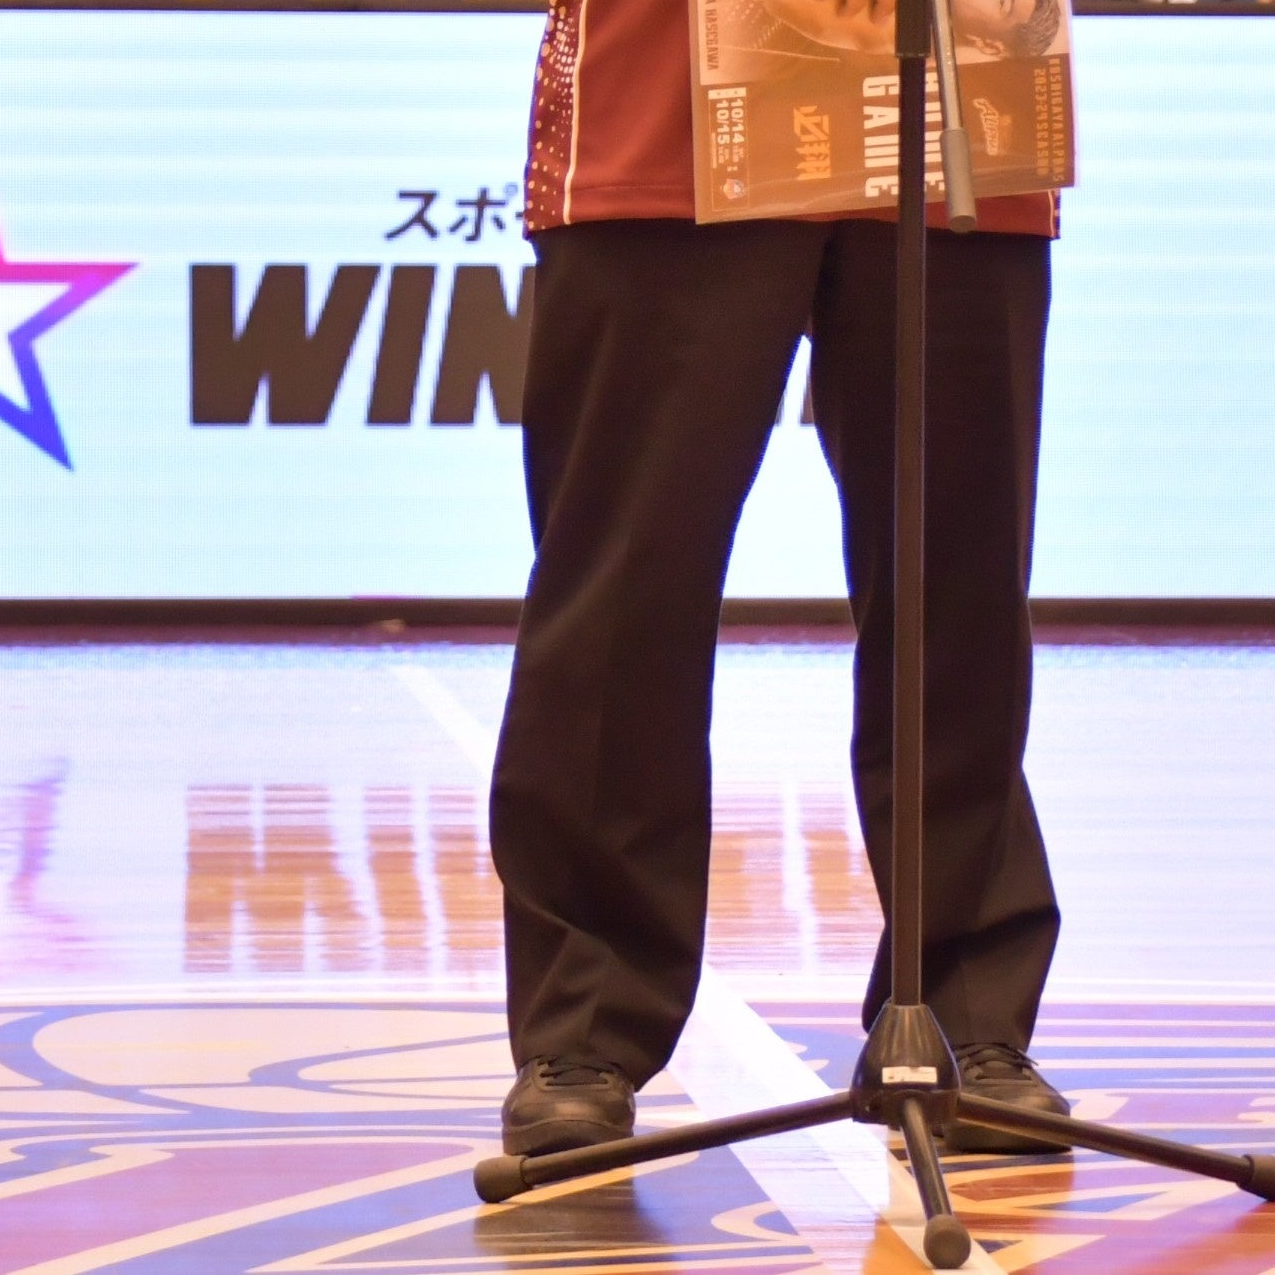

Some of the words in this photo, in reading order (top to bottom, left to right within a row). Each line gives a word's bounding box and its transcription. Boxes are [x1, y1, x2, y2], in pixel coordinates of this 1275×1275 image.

[716, 100, 730, 145] 10/15
[730, 98, 745, 143] 10/14
[862, 75, 900, 198] GAME
